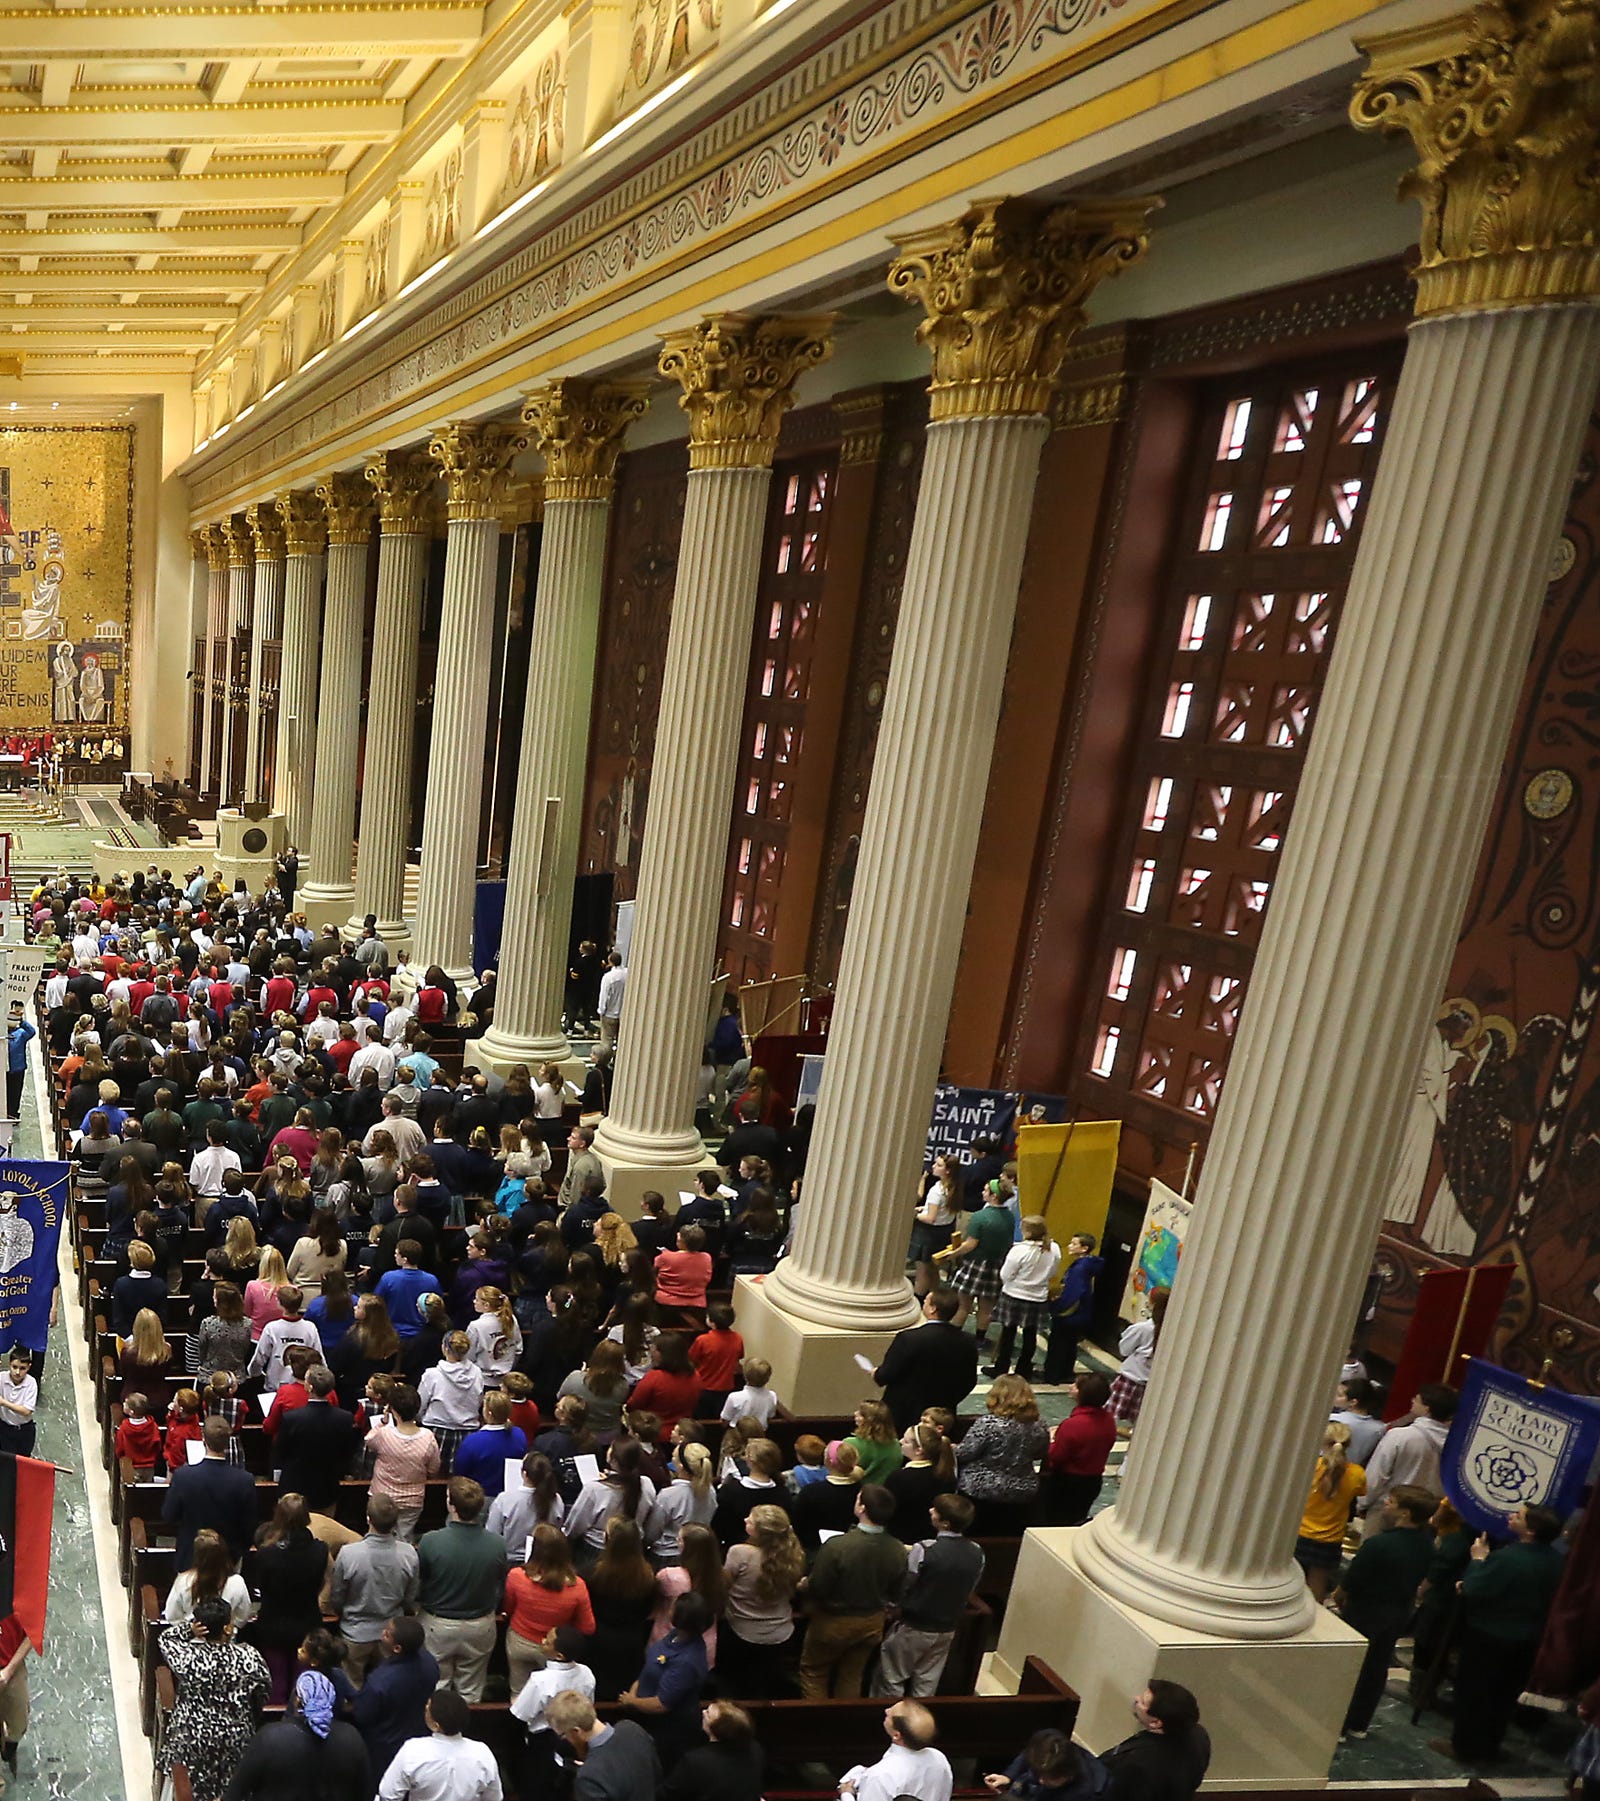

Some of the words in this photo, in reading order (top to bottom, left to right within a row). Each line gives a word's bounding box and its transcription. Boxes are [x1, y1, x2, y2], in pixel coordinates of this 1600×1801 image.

[12, 963, 42, 972] FRANCIS
[8, 974, 31, 982] SALES
[7, 984, 27, 993] HOOL
[934, 1104, 996, 1125] SAINT
[923, 1145, 977, 1166] SCHO
[2, 1169, 39, 1192] LOYOLA
[36, 1188, 57, 1228] SCHOOL
[0, 1274, 32, 1286] Greater
[9, 1284, 28, 1296] God
[1487, 1412, 1556, 1449] SCHOOL
[1516, 1411, 1564, 1438] MARY
